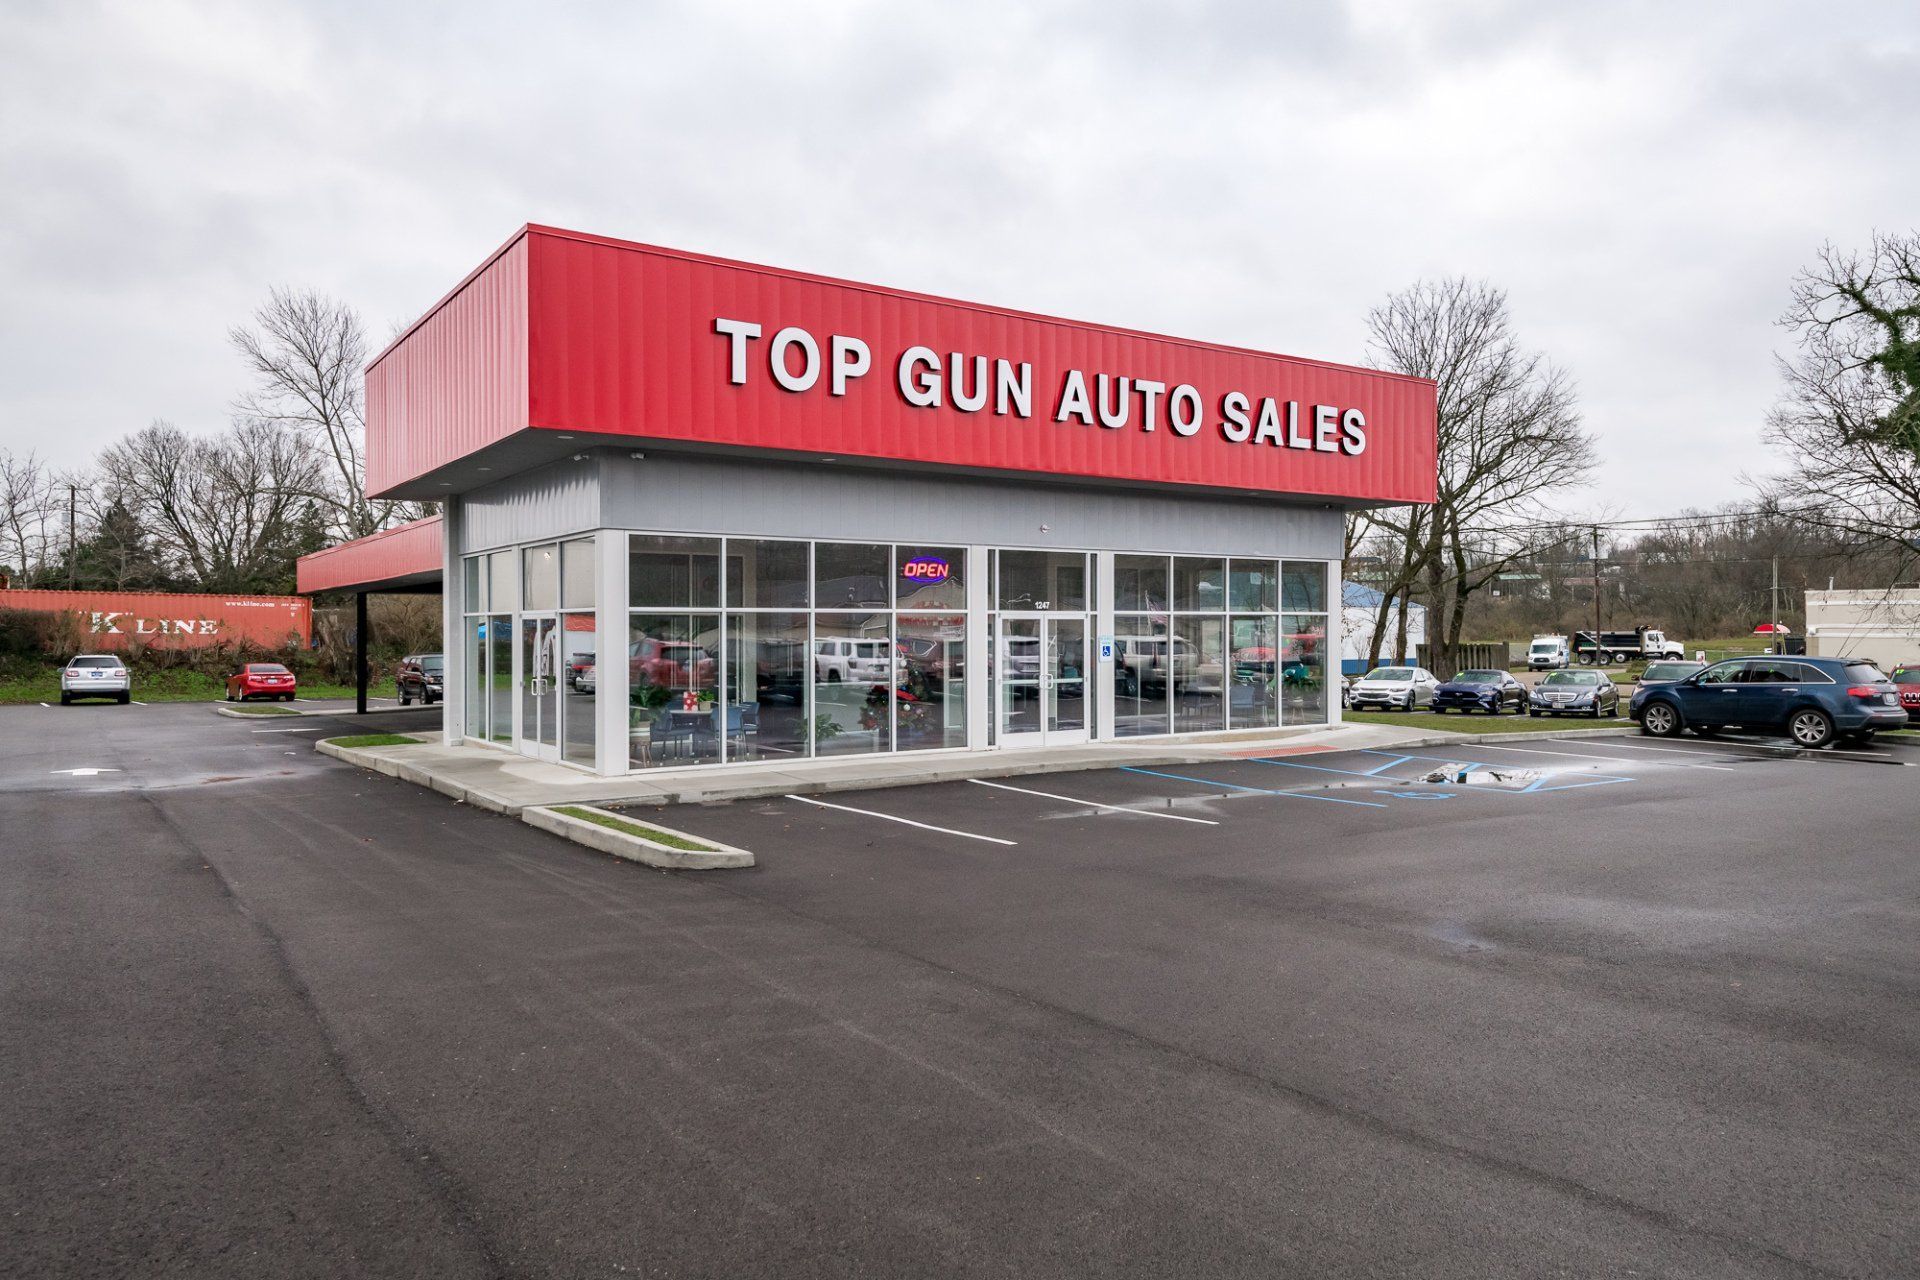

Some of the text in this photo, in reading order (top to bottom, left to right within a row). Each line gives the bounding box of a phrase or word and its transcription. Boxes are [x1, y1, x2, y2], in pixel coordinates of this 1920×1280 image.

[714, 317, 1367, 456] TOP GUN AUTO SALES
[904, 562, 949, 578] OPEN
[1034, 601, 1050, 610] 1247
[136, 618, 219, 635] LINE
